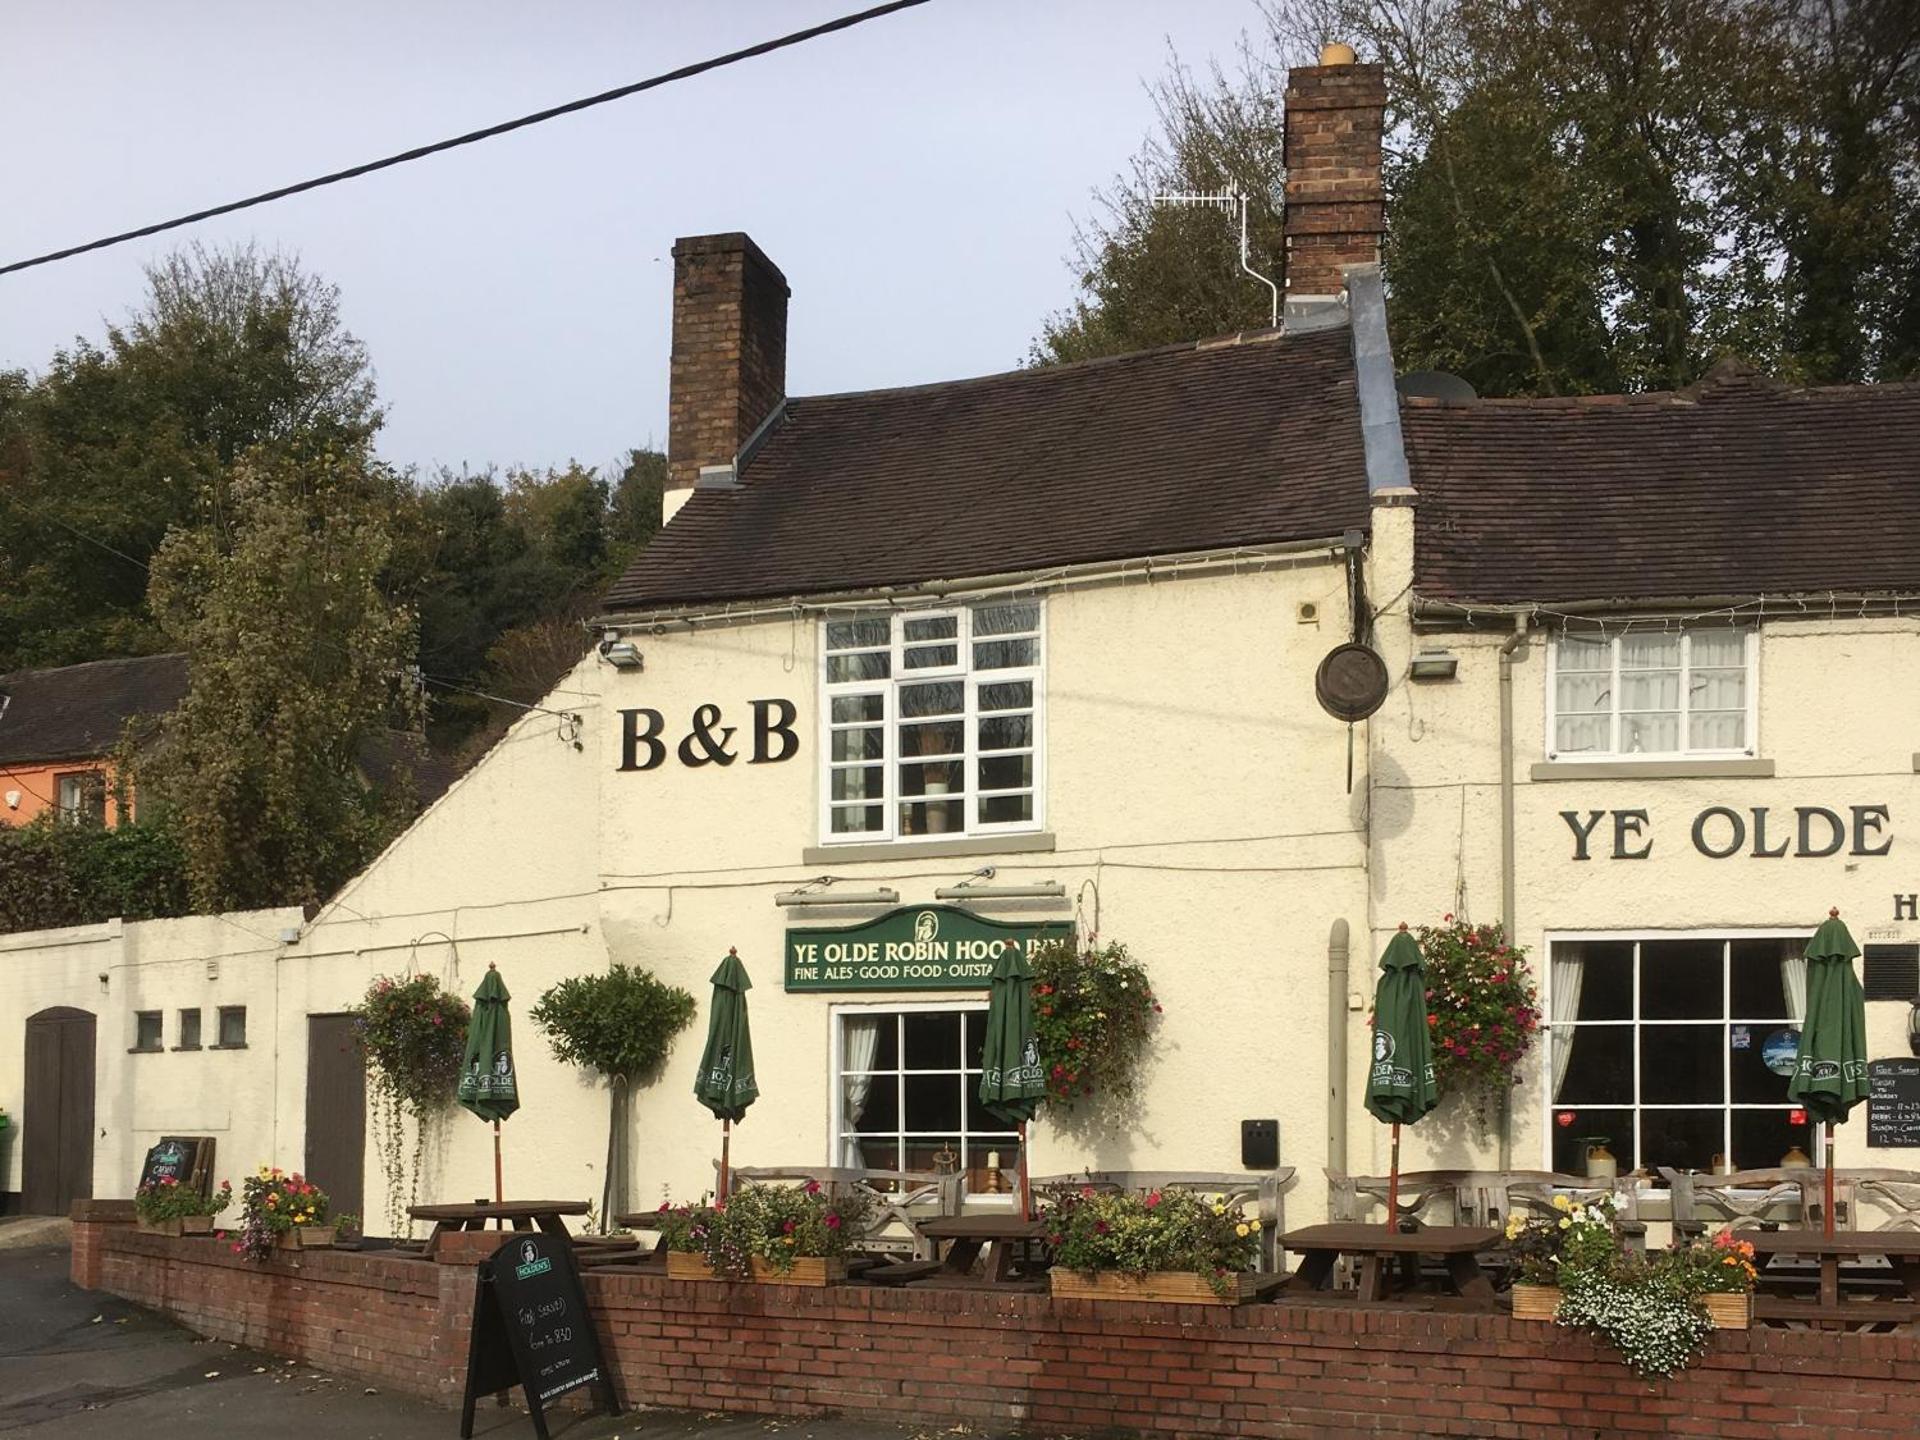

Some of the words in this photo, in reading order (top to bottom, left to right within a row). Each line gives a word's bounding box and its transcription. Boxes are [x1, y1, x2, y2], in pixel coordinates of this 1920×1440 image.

[616, 698, 800, 772] B&B
[1559, 808, 1654, 861] YE
[1691, 803, 1894, 860] OLDE
[794, 943, 819, 964] YE
[824, 942, 880, 963] OLDE
[885, 940, 949, 962] ROBIN
[955, 939, 1020, 960] HOO
[794, 967, 819, 980] FINE
[824, 966, 854, 979] ALES
[859, 965, 899, 979] GOOD
[903, 964, 941, 978] FOOD
[949, 963, 993, 977] OUTSTA
